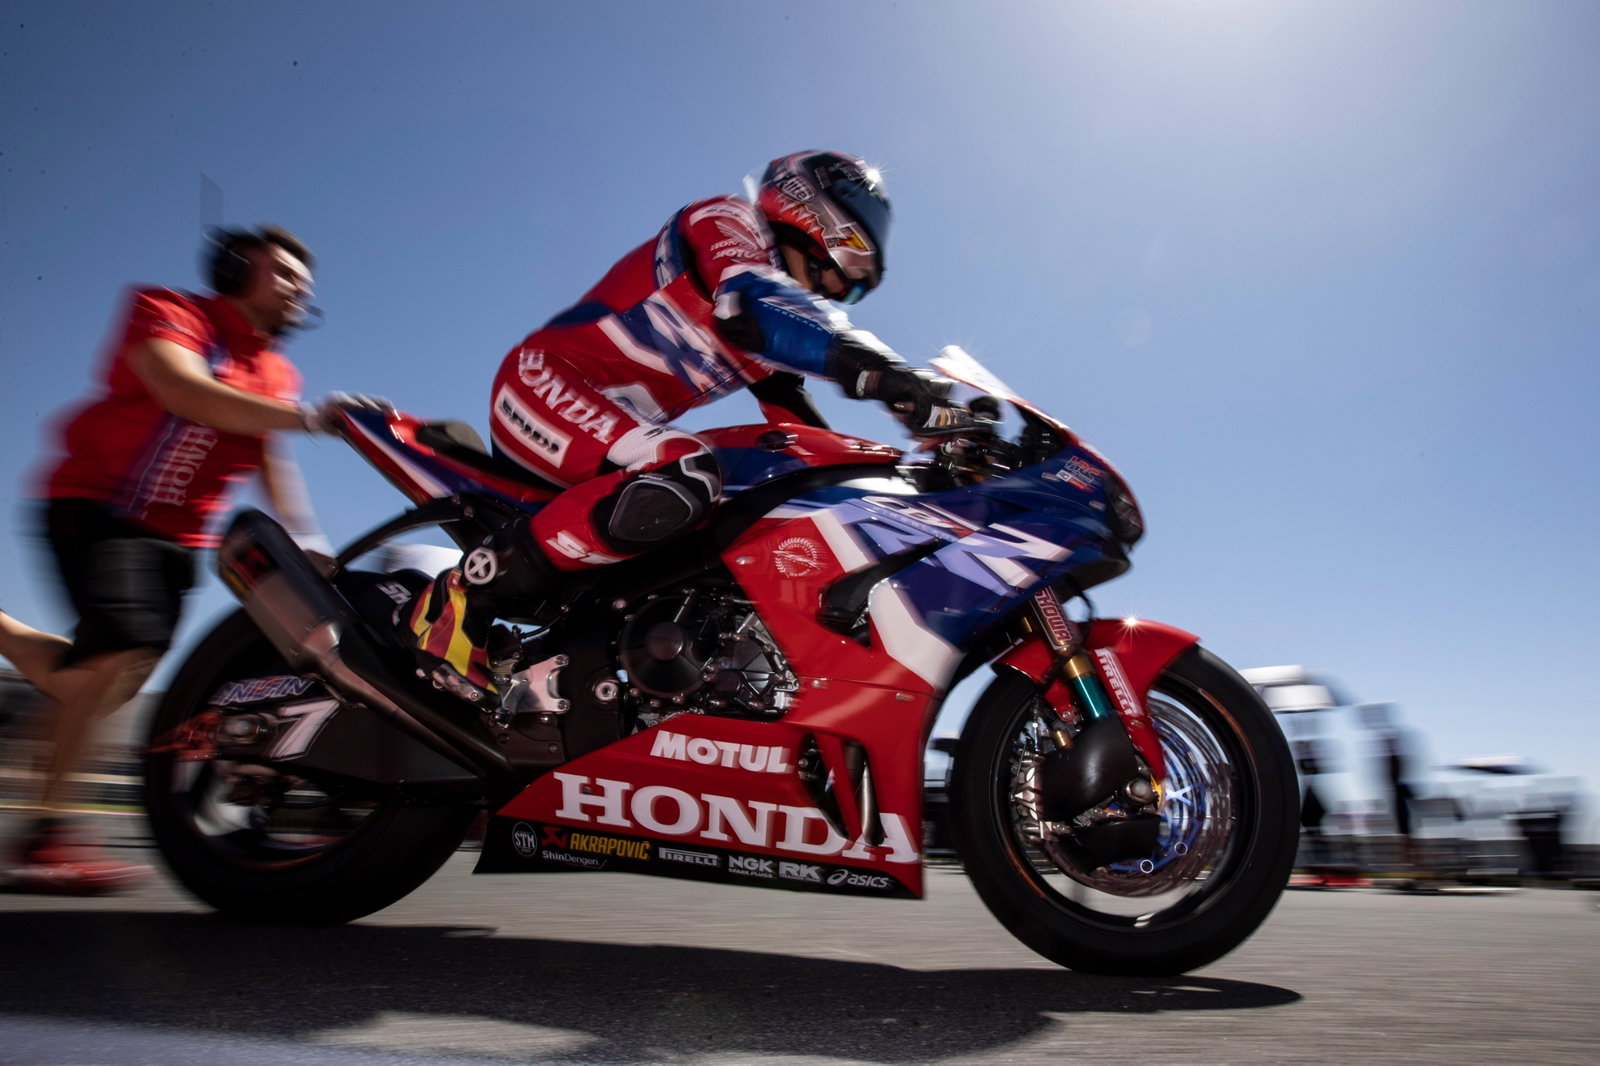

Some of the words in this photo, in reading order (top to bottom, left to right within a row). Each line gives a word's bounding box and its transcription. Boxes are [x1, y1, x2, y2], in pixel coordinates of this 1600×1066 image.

[518, 348, 616, 445] HONDA
[1034, 586, 1073, 642] SHOWA
[1095, 648, 1142, 717] PIRELLI
[266, 699, 341, 761] 7
[650, 730, 789, 774] MOTUL
[553, 772, 919, 864] HONDA
[514, 832, 536, 849] STM
[542, 850, 599, 866] ShinDengen
[658, 846, 719, 867] PIRELLI
[728, 854, 773, 874] NGK
[779, 860, 821, 880] RK
